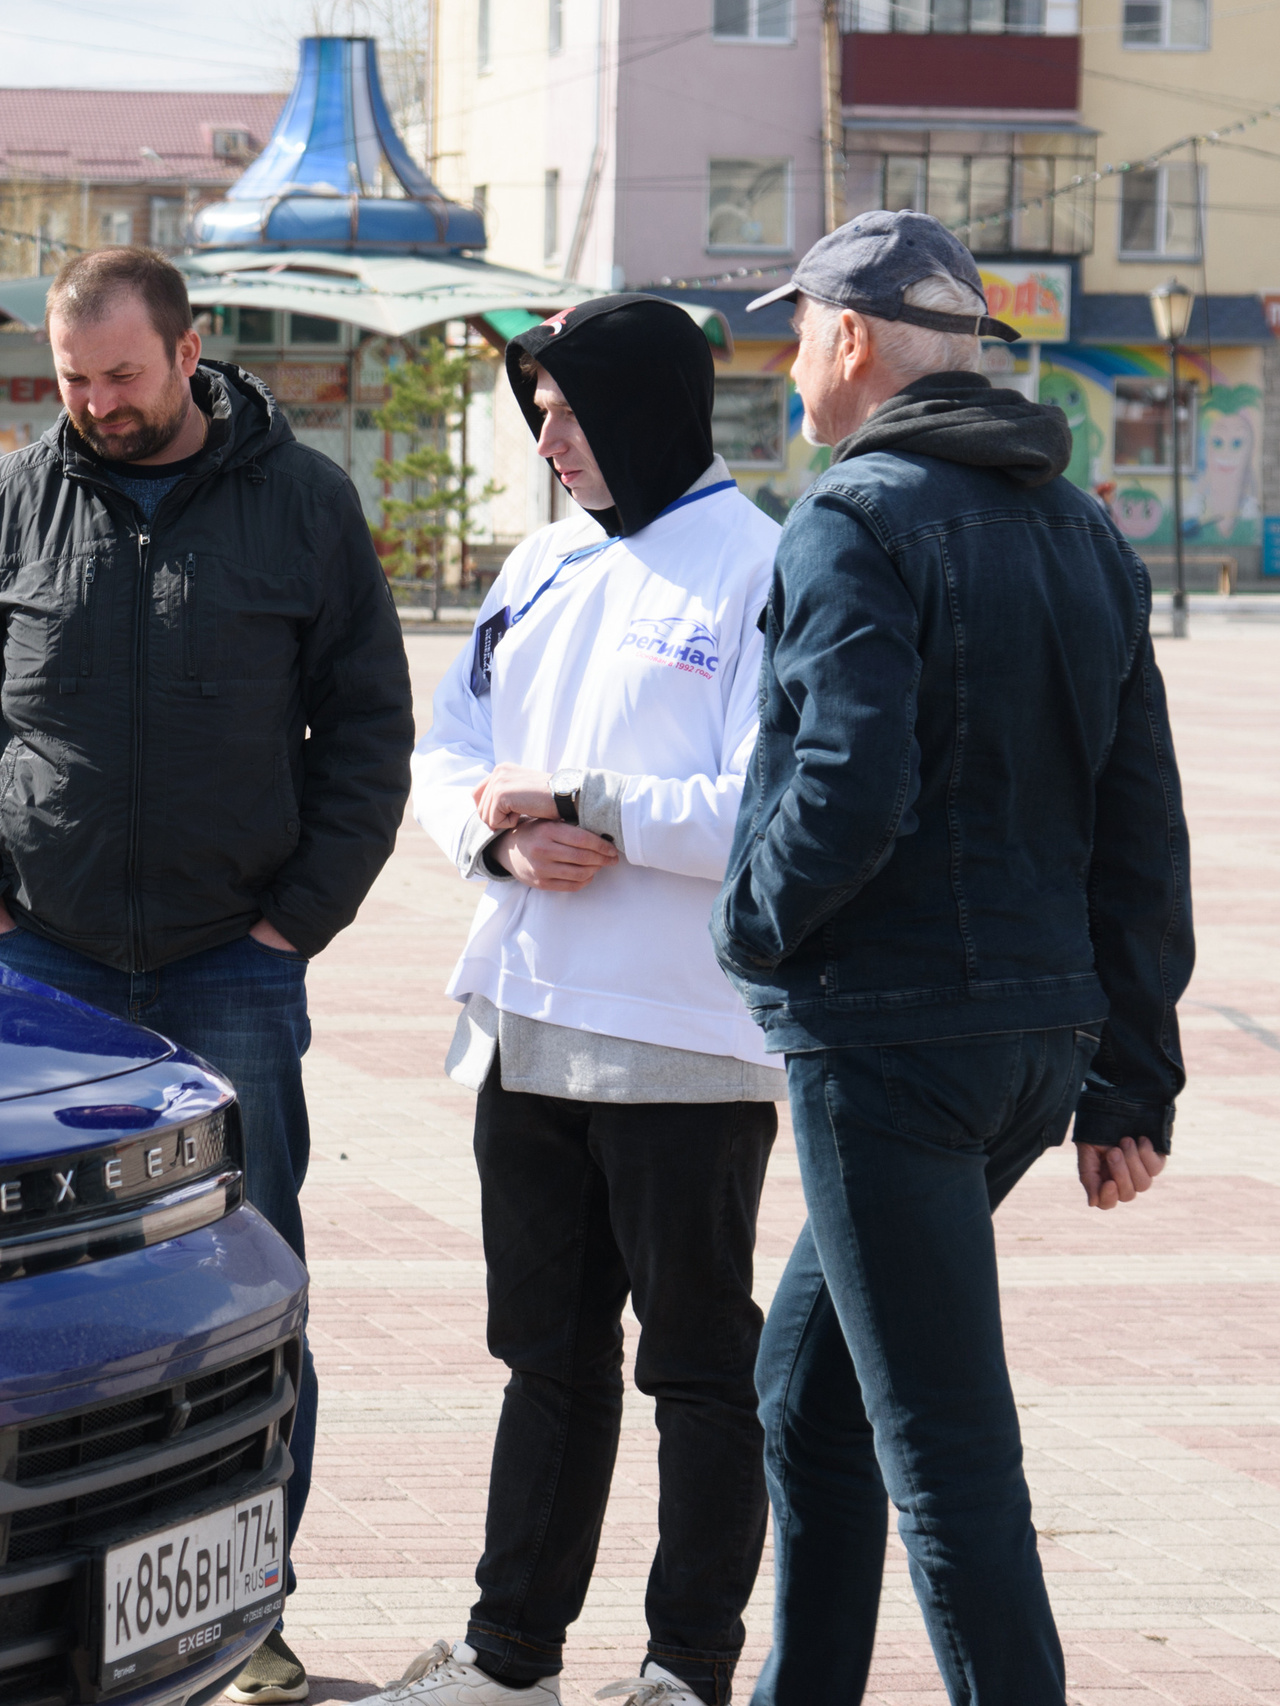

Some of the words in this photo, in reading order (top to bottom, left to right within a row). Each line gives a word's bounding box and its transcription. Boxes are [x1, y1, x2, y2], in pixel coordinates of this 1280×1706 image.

[675, 661, 695, 673] 1992
[0, 1137, 196, 1213] EXEED
[238, 1499, 278, 1573] 774
[244, 1567, 265, 1596] RUS
[178, 1623, 222, 1655] EXEED
